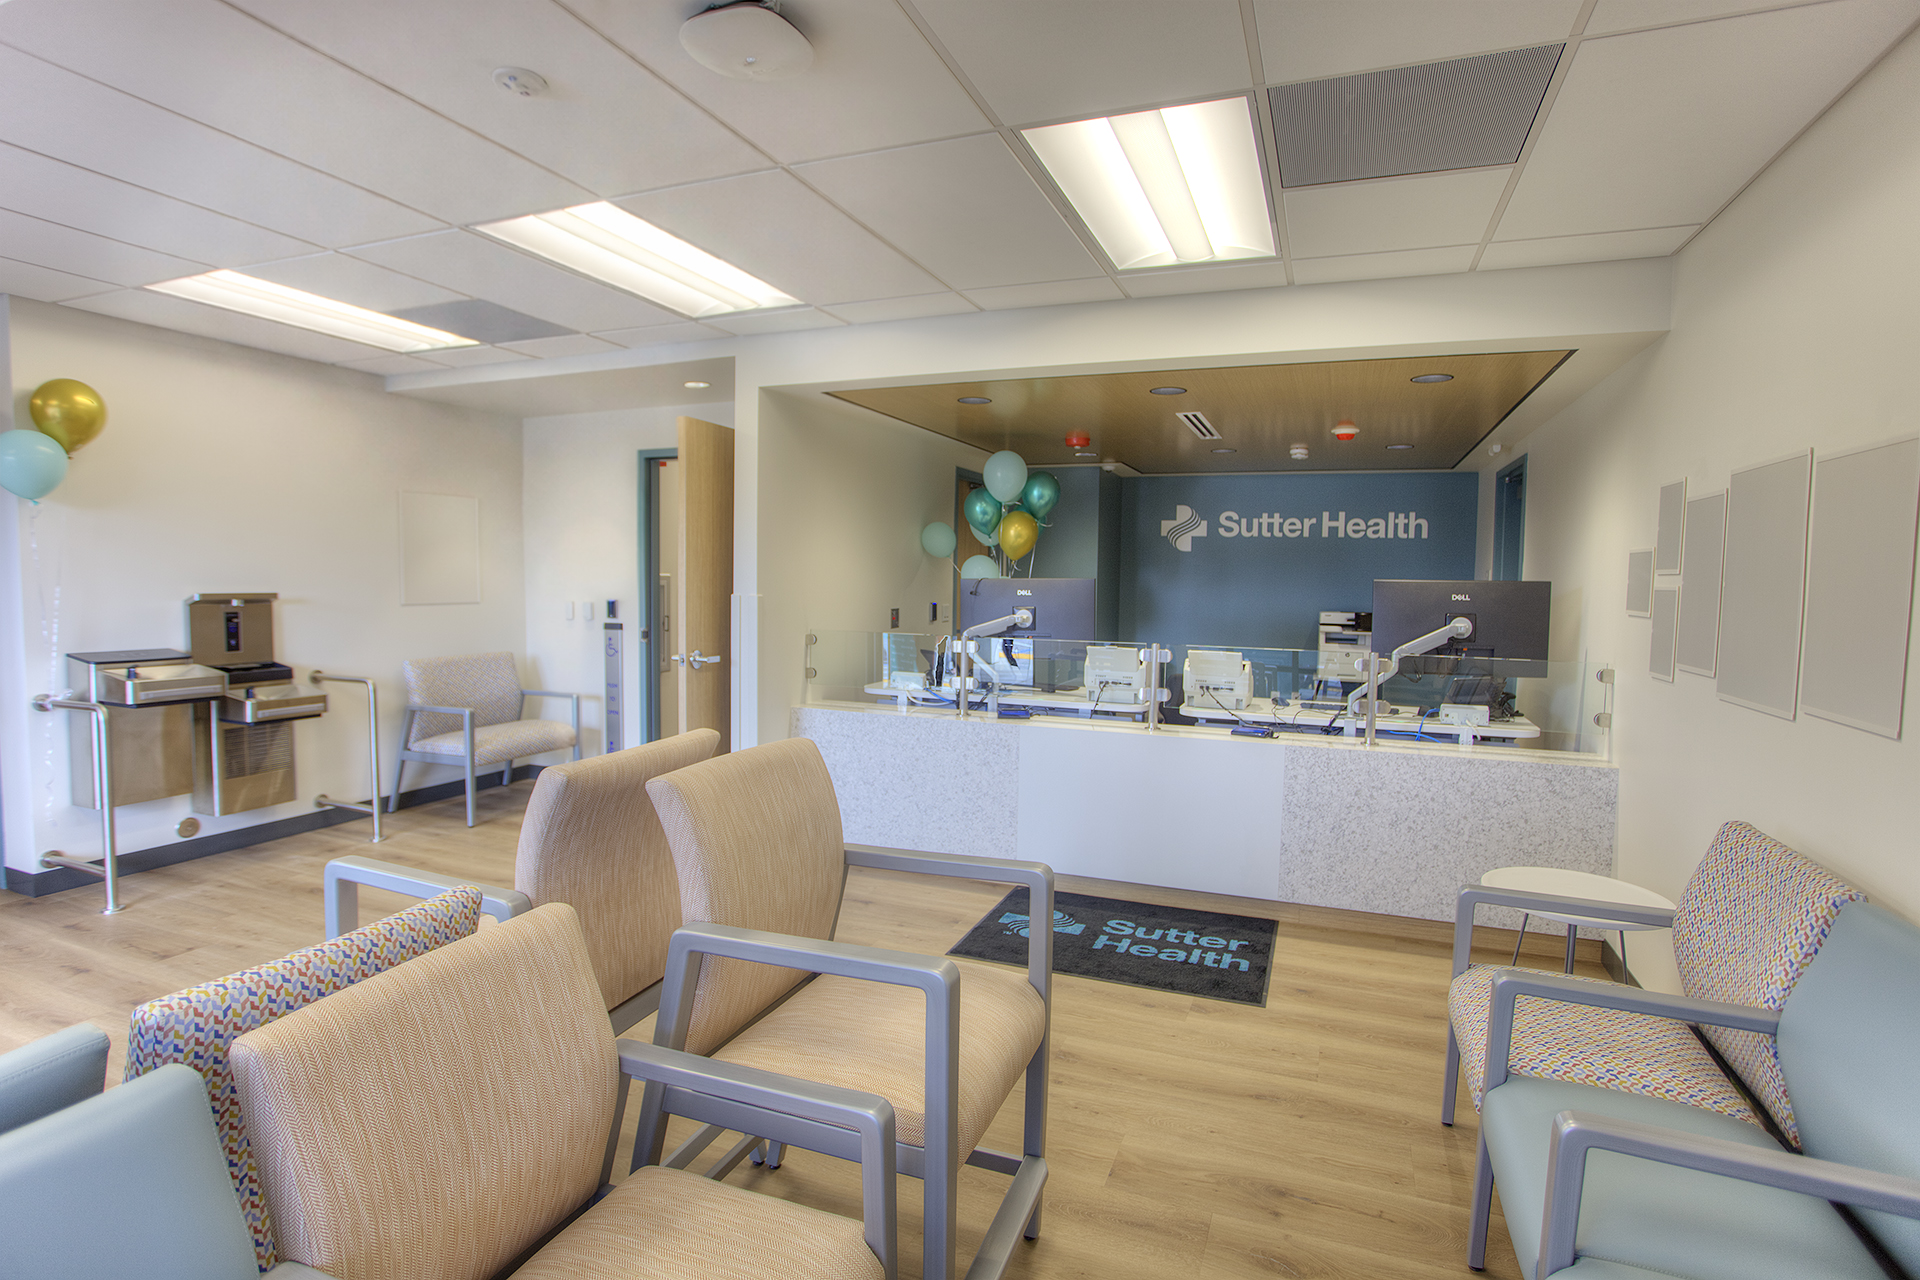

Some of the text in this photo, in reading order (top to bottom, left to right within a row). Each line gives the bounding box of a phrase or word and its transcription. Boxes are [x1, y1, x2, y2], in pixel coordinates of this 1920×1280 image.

[1218, 511, 1428, 539] Sutter Health
[1451, 593, 1470, 601] DELL
[1102, 919, 1249, 951] Sutter
[1092, 935, 1250, 972] Health
